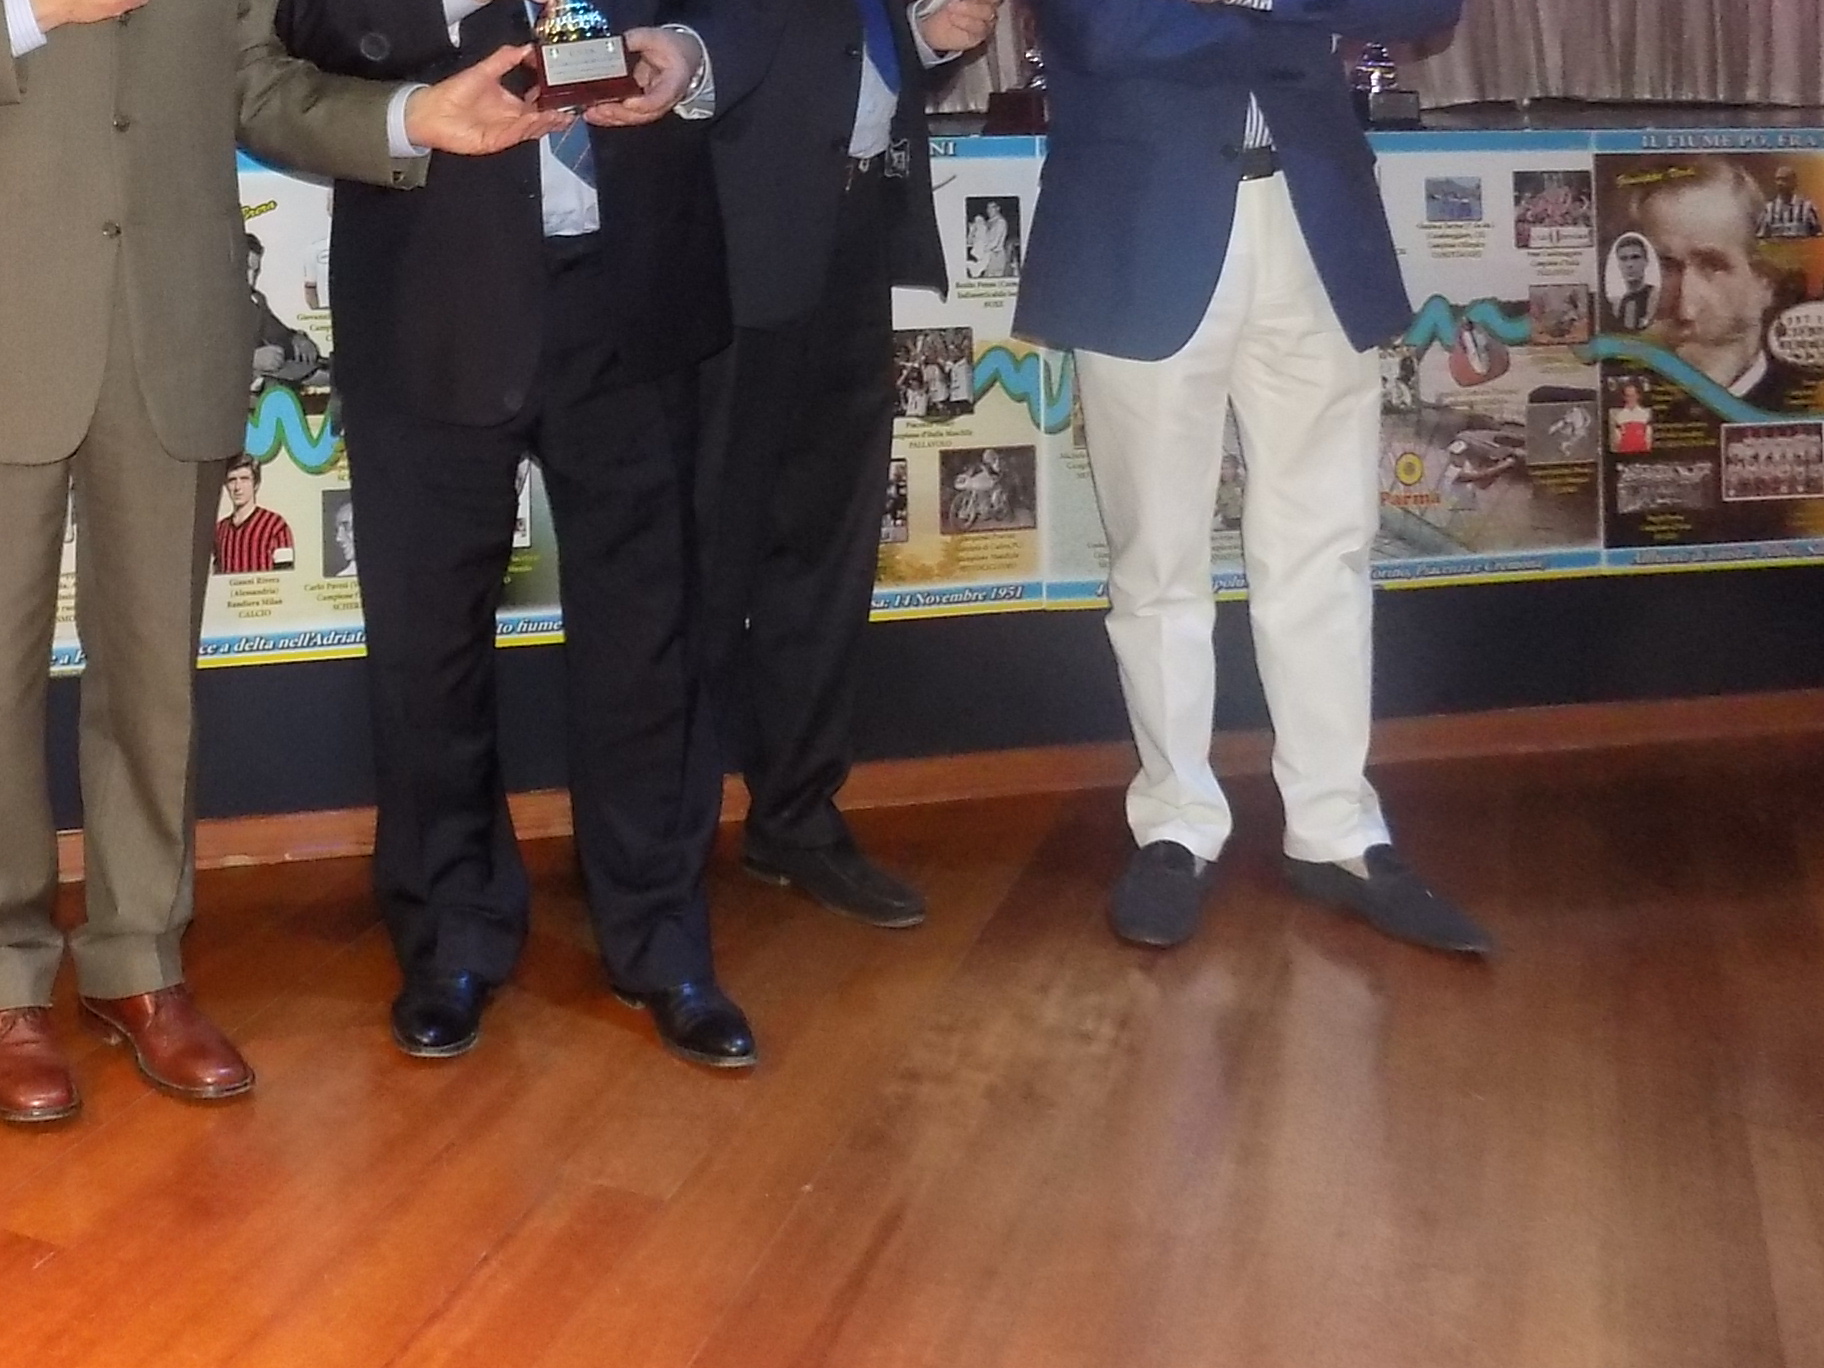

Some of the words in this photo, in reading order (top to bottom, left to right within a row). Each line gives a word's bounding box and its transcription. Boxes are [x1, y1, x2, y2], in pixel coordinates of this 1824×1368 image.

[1667, 134, 1733, 148] FIUME
[914, 587, 985, 606] Novembre
[989, 585, 1025, 601] 1951
[517, 617, 564, 633] fiume
[234, 636, 274, 652] delta
